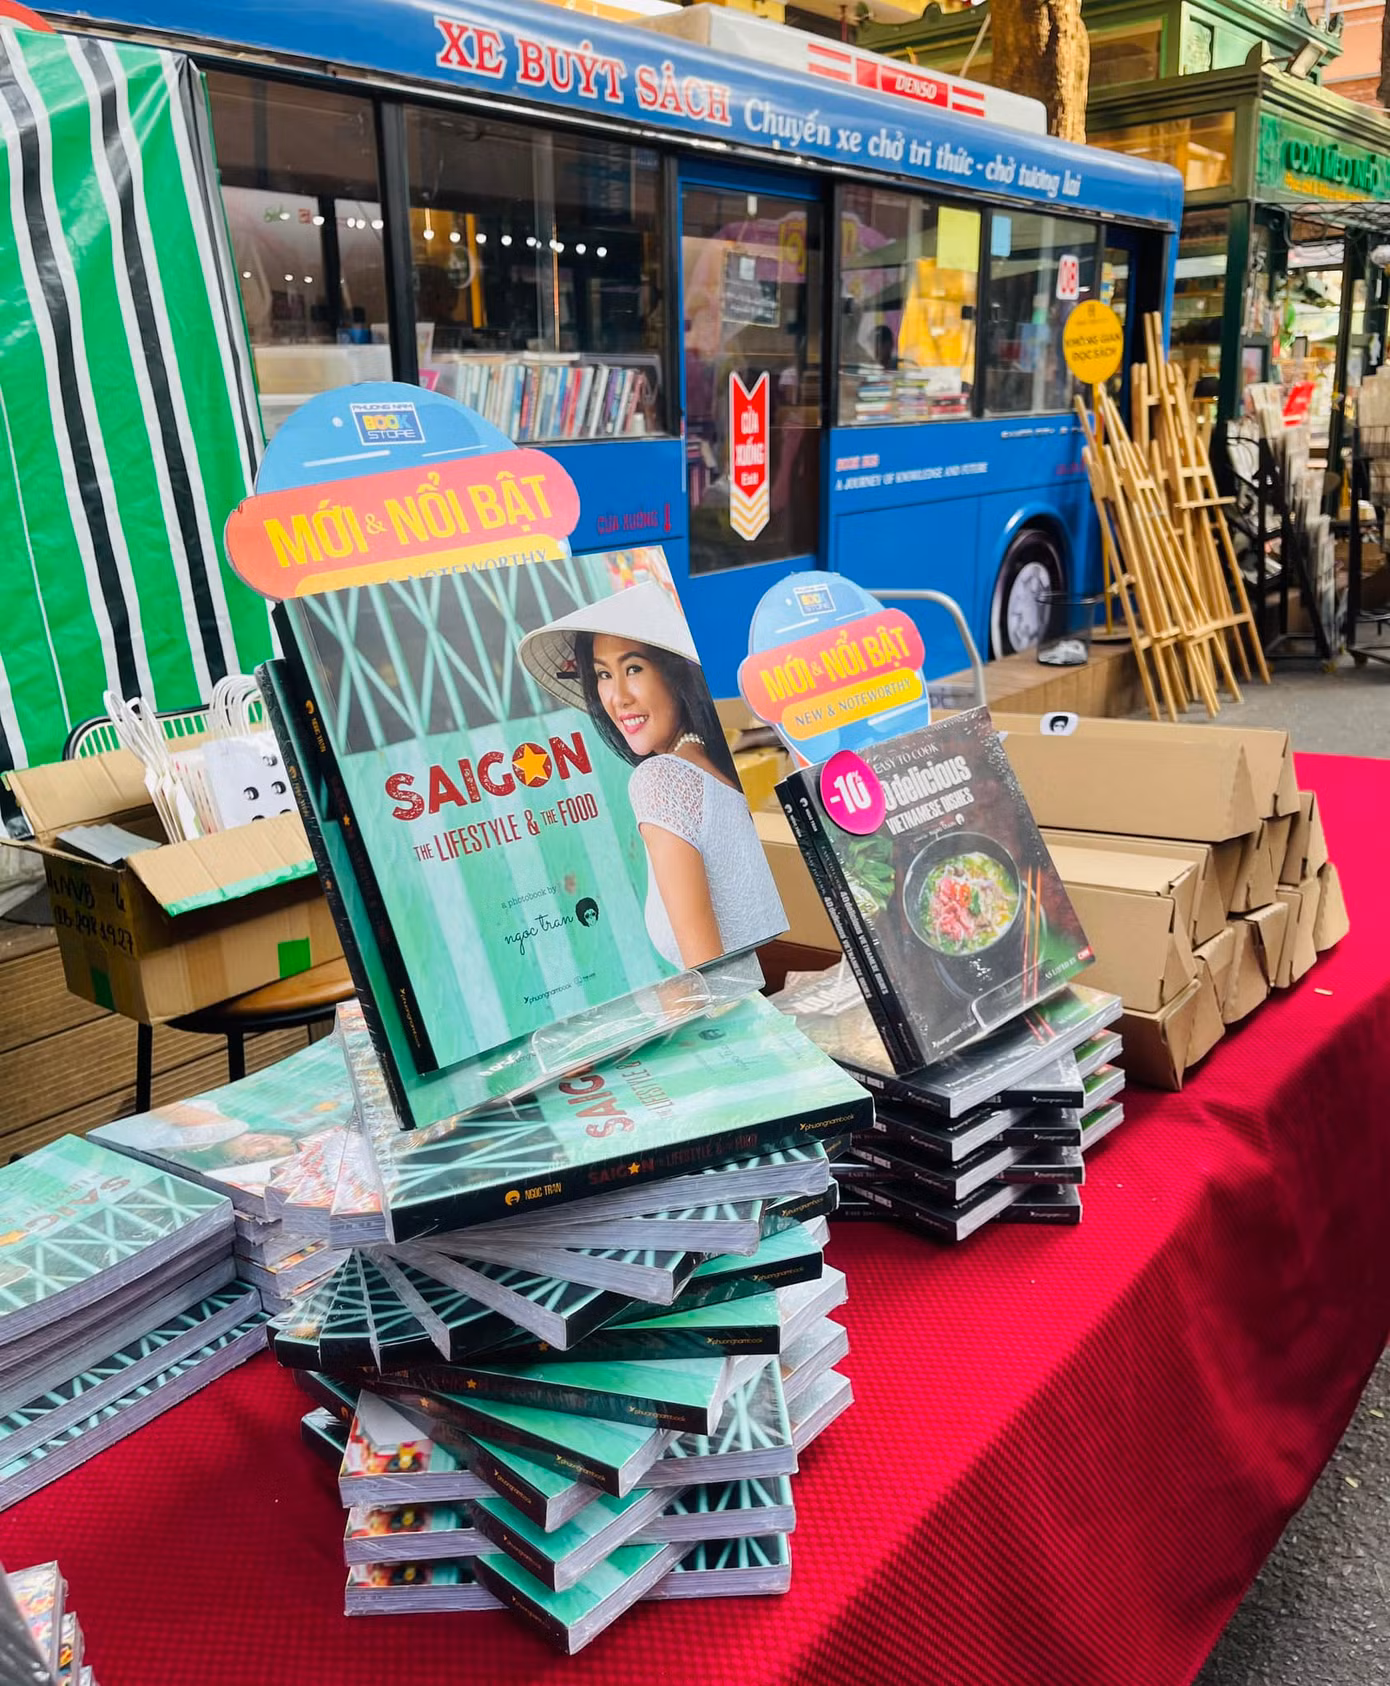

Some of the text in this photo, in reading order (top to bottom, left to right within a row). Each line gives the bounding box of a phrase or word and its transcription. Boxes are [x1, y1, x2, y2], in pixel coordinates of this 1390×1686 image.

[434, 17, 731, 126] XE BUÝT SÁCH
[895, 75, 937, 99] DENSO
[743, 98, 831, 147] Chuyến
[836, 128, 862, 153] xe
[868, 127, 905, 161] chở
[935, 142, 974, 175] thức
[985, 154, 1016, 184] chở
[362, 412, 413, 431] BOOK
[367, 428, 416, 440] STORE
[263, 470, 553, 568] MỚI & NỔI BẬT
[759, 625, 911, 702] MỚI & NỔI BẬT
[794, 678, 912, 727] NEW & NOTEWORTHY
[384, 731, 594, 822] SAIGON
[873, 742, 939, 775] EASY TO COOK
[413, 793, 600, 863] THE LIFESTYLE & THE FOOD
[885, 799, 945, 836] VIETNAMESE
[939, 786, 975, 814] DISHES
[508, 888, 548, 910] photobook
[839, 890, 850, 903] 40
[504, 913, 574, 956] ngoc tran
[559, 1065, 634, 1139] SAIG
[524, 1186, 544, 1201] NGOC
[543, 1182, 562, 1198] TRAN
